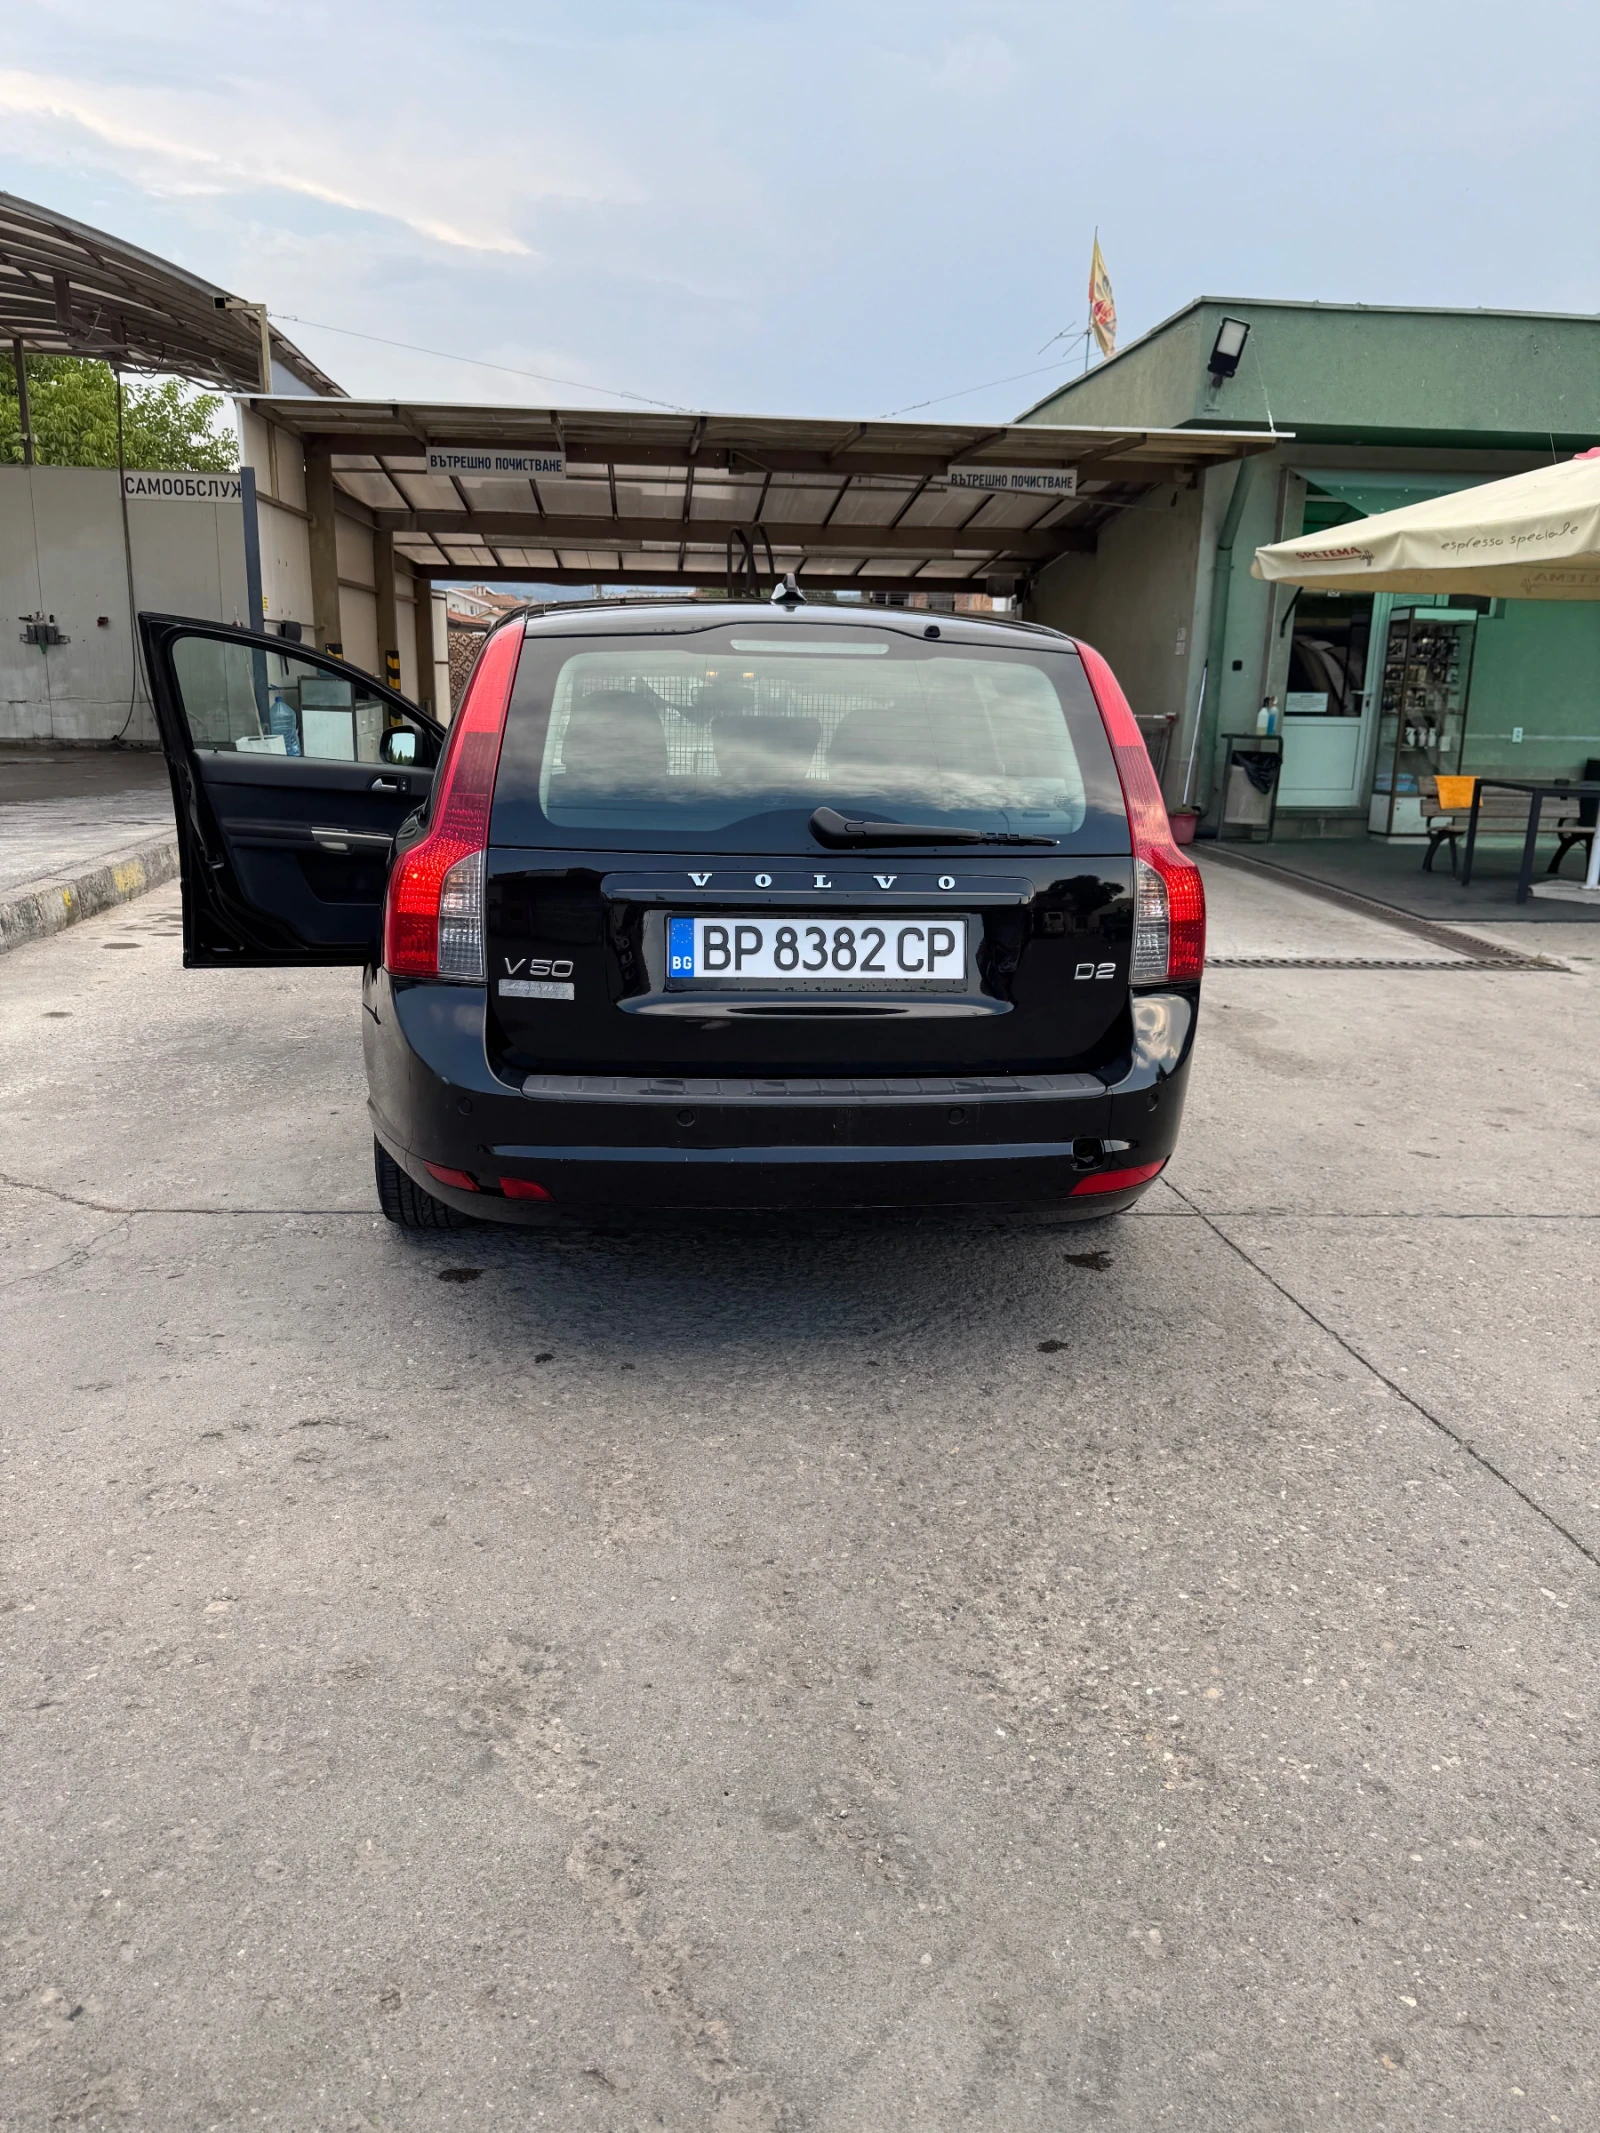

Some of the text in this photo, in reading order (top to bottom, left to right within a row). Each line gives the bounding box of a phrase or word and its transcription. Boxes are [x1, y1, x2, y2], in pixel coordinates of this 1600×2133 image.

[430, 455, 562, 472] ВЪТРЕШНО ПОЧИСТВАНЕ
[951, 473, 1073, 489] ВЪТРЕШНО ПОЧИСТВАНЕ
[1295, 547, 1361, 559] SPETEMA
[1441, 537, 1504, 556] espresso
[688, 873, 956, 890] VOLVO
[703, 925, 956, 972] BP 8382 CP
[672, 955, 692, 970] BG
[1074, 962, 1117, 980] D2
